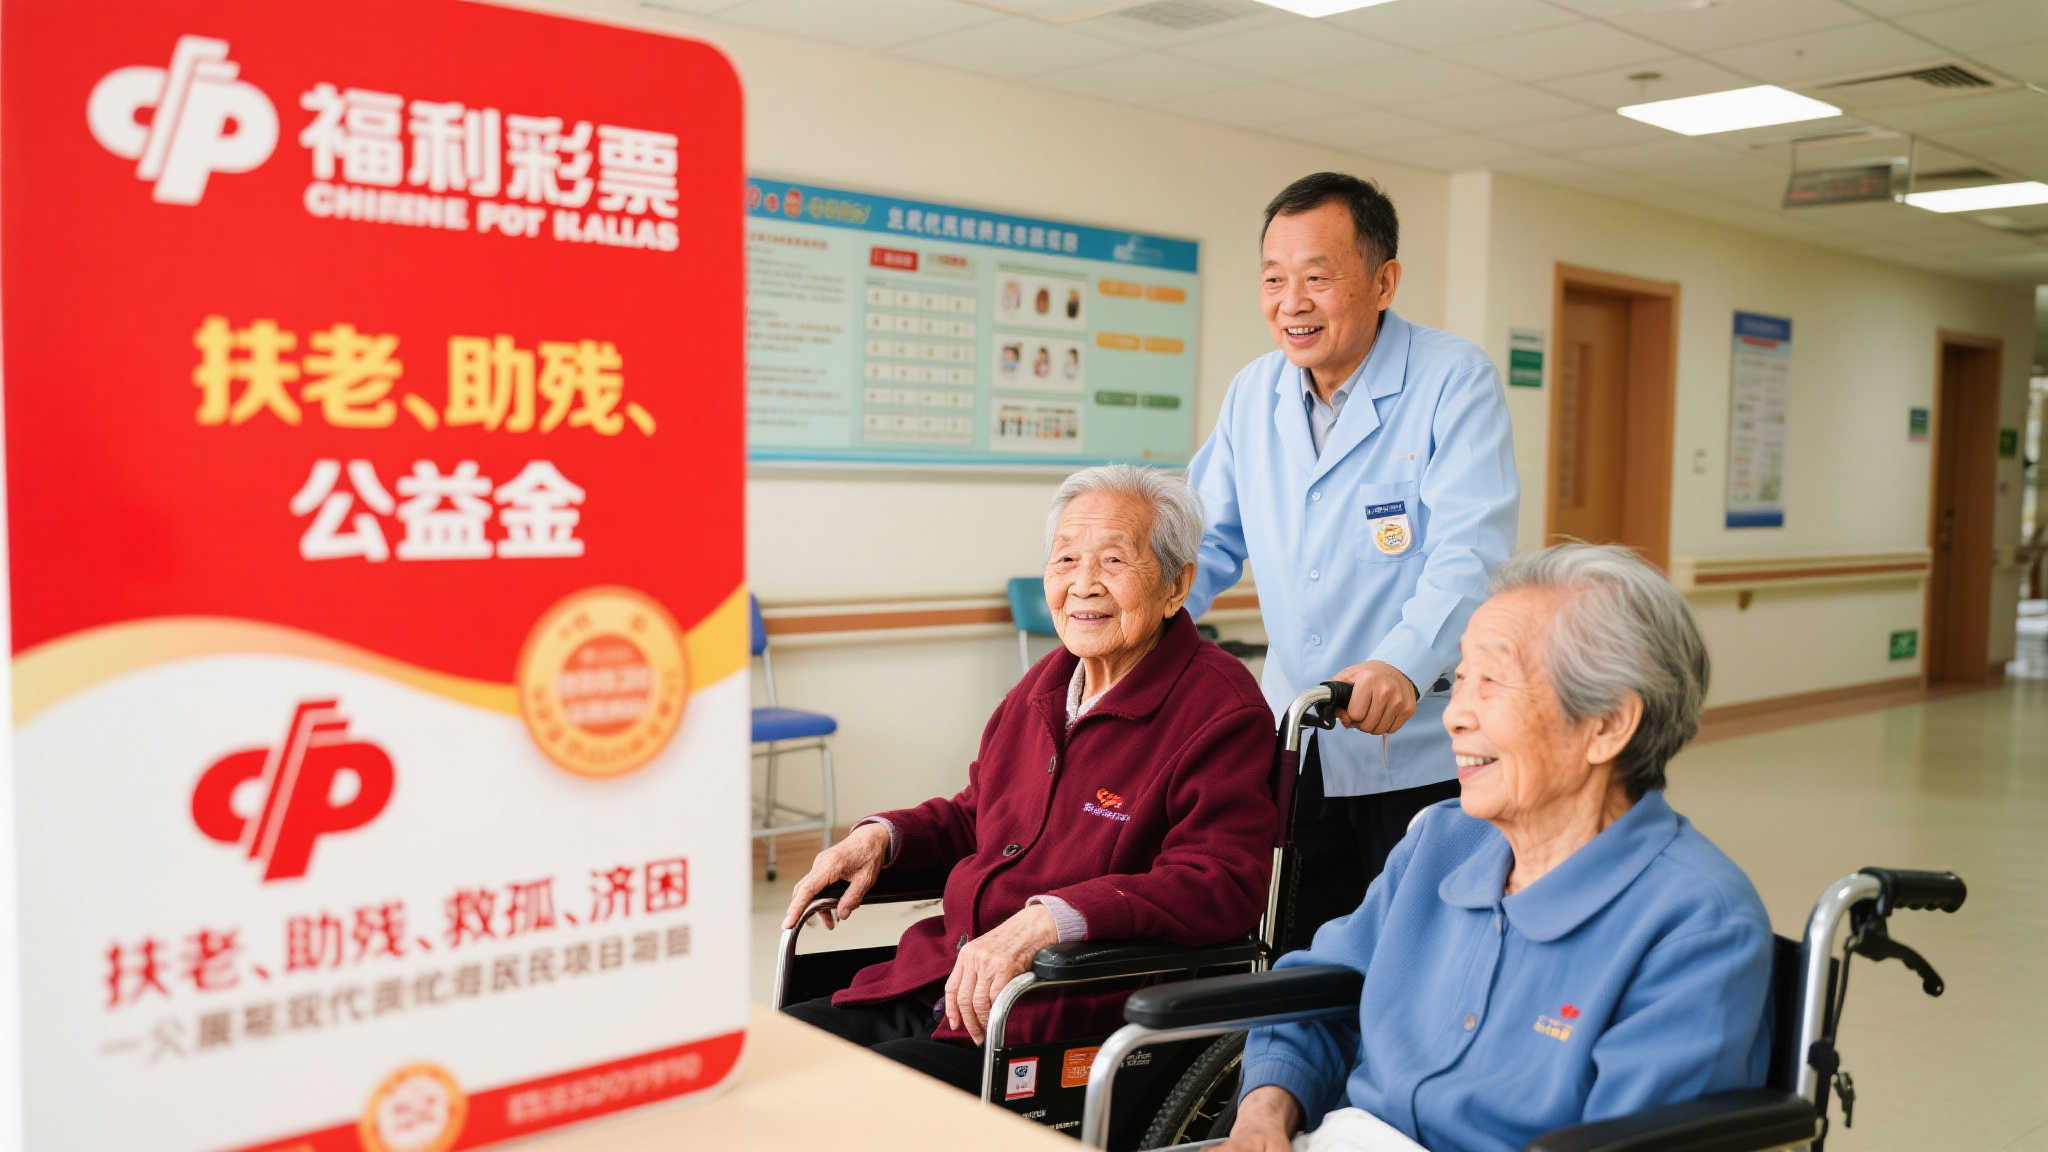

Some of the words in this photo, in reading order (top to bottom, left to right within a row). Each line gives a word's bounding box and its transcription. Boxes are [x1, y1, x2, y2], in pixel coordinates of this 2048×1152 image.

[299, 84, 679, 218] 福利彩票
[193, 317, 656, 436] 扶老、助残、
[290, 459, 586, 562] 公益金
